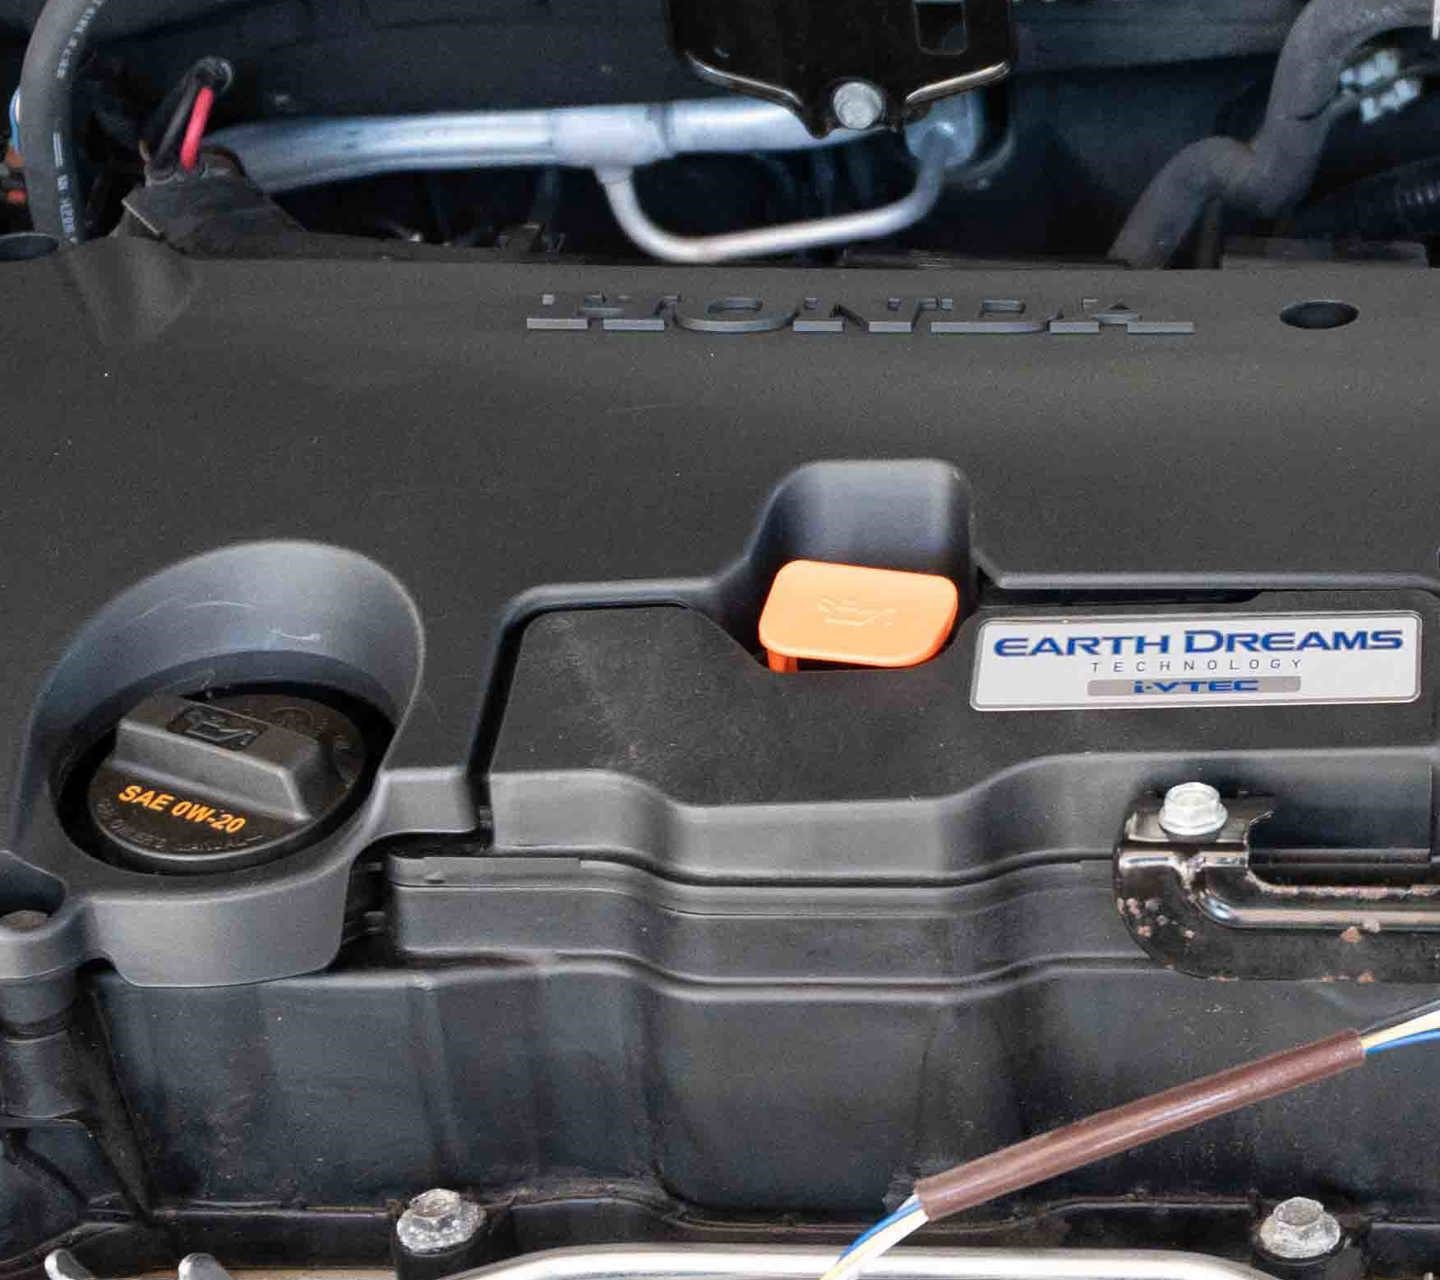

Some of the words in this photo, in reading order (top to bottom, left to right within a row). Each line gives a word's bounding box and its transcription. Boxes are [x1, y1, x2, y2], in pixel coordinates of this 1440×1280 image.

[526, 293, 1195, 334] HONDA
[993, 635, 1169, 658] EARTH
[1184, 629, 1404, 654] DREAMS
[1090, 658, 1303, 673] TECHNOLOGY
[1133, 679, 1260, 695] i-VTEC
[118, 785, 174, 811] SAE
[171, 800, 247, 833] 0W-20
